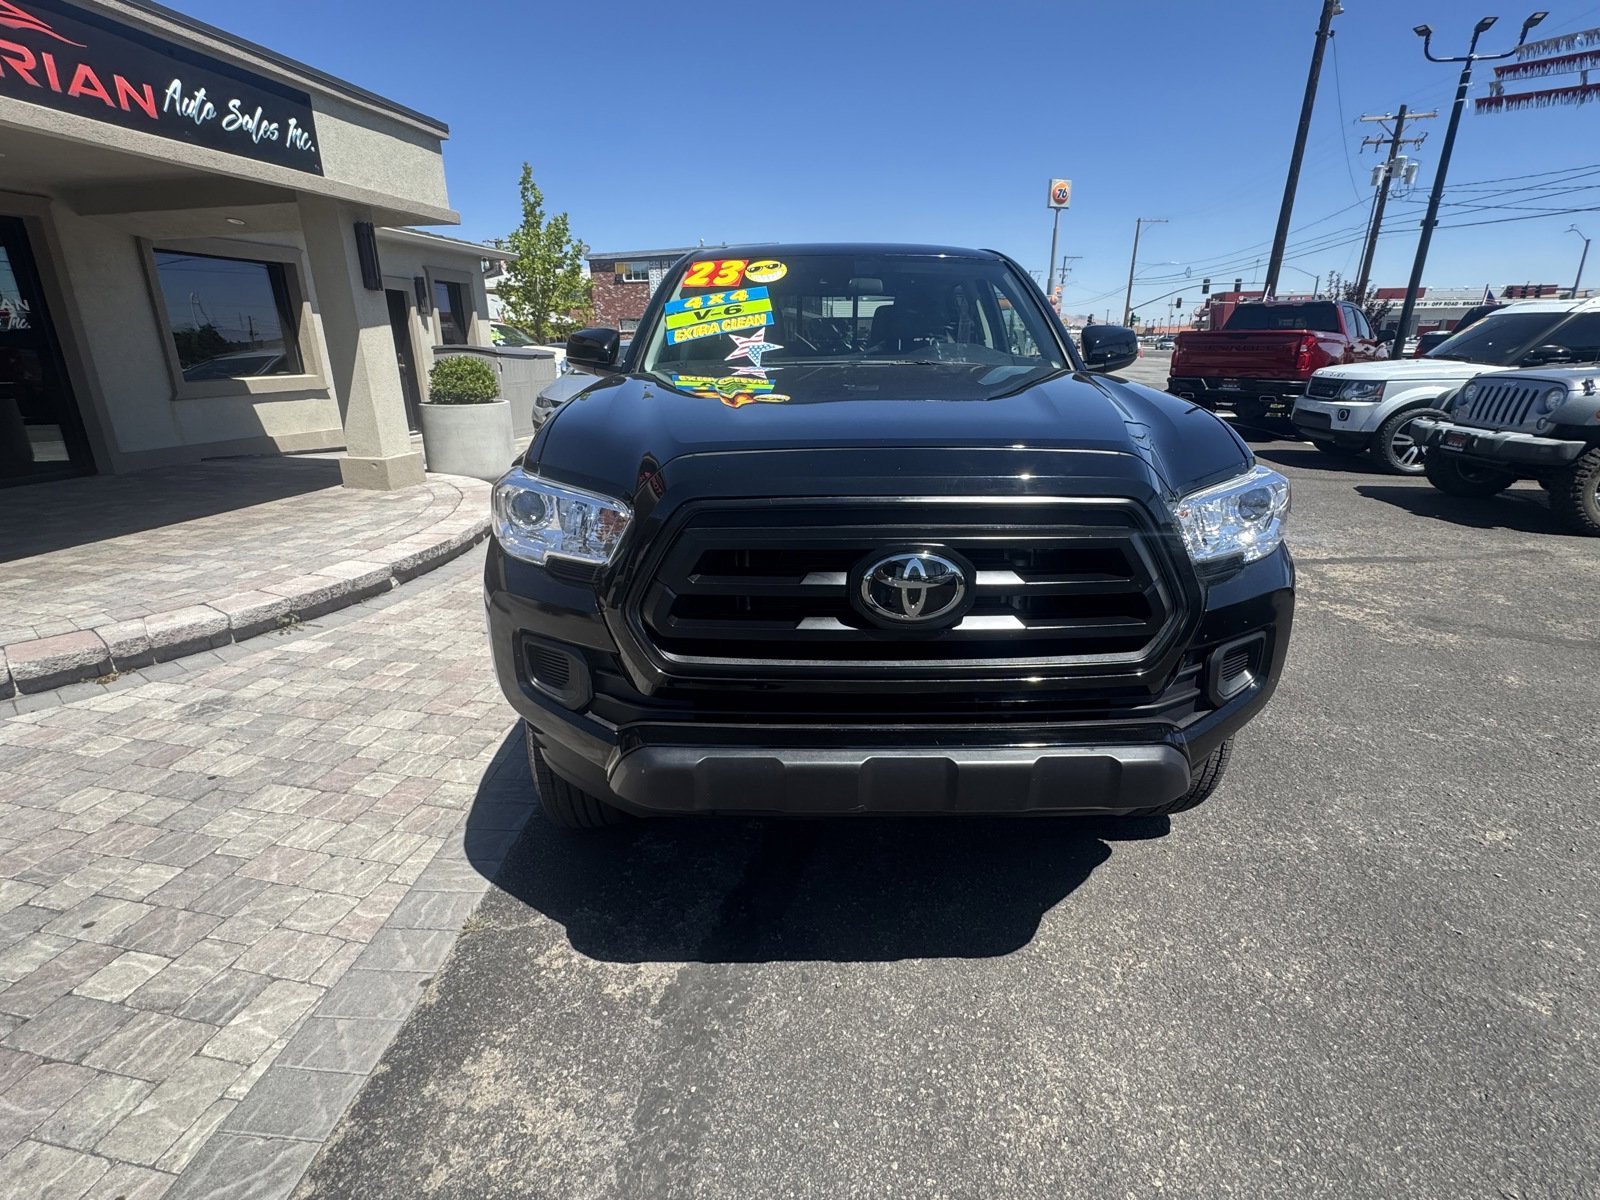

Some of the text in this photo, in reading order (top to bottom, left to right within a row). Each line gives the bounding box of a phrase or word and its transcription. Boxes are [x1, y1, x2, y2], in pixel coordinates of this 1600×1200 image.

[163, 78, 216, 125] Auto
[222, 99, 279, 144] Sales
[286, 117, 315, 152] Inc.
[1057, 187, 1067, 198] 76
[683, 260, 745, 285] 23
[694, 304, 743, 321] V-6
[674, 314, 766, 343] EXTRA CLEAN
